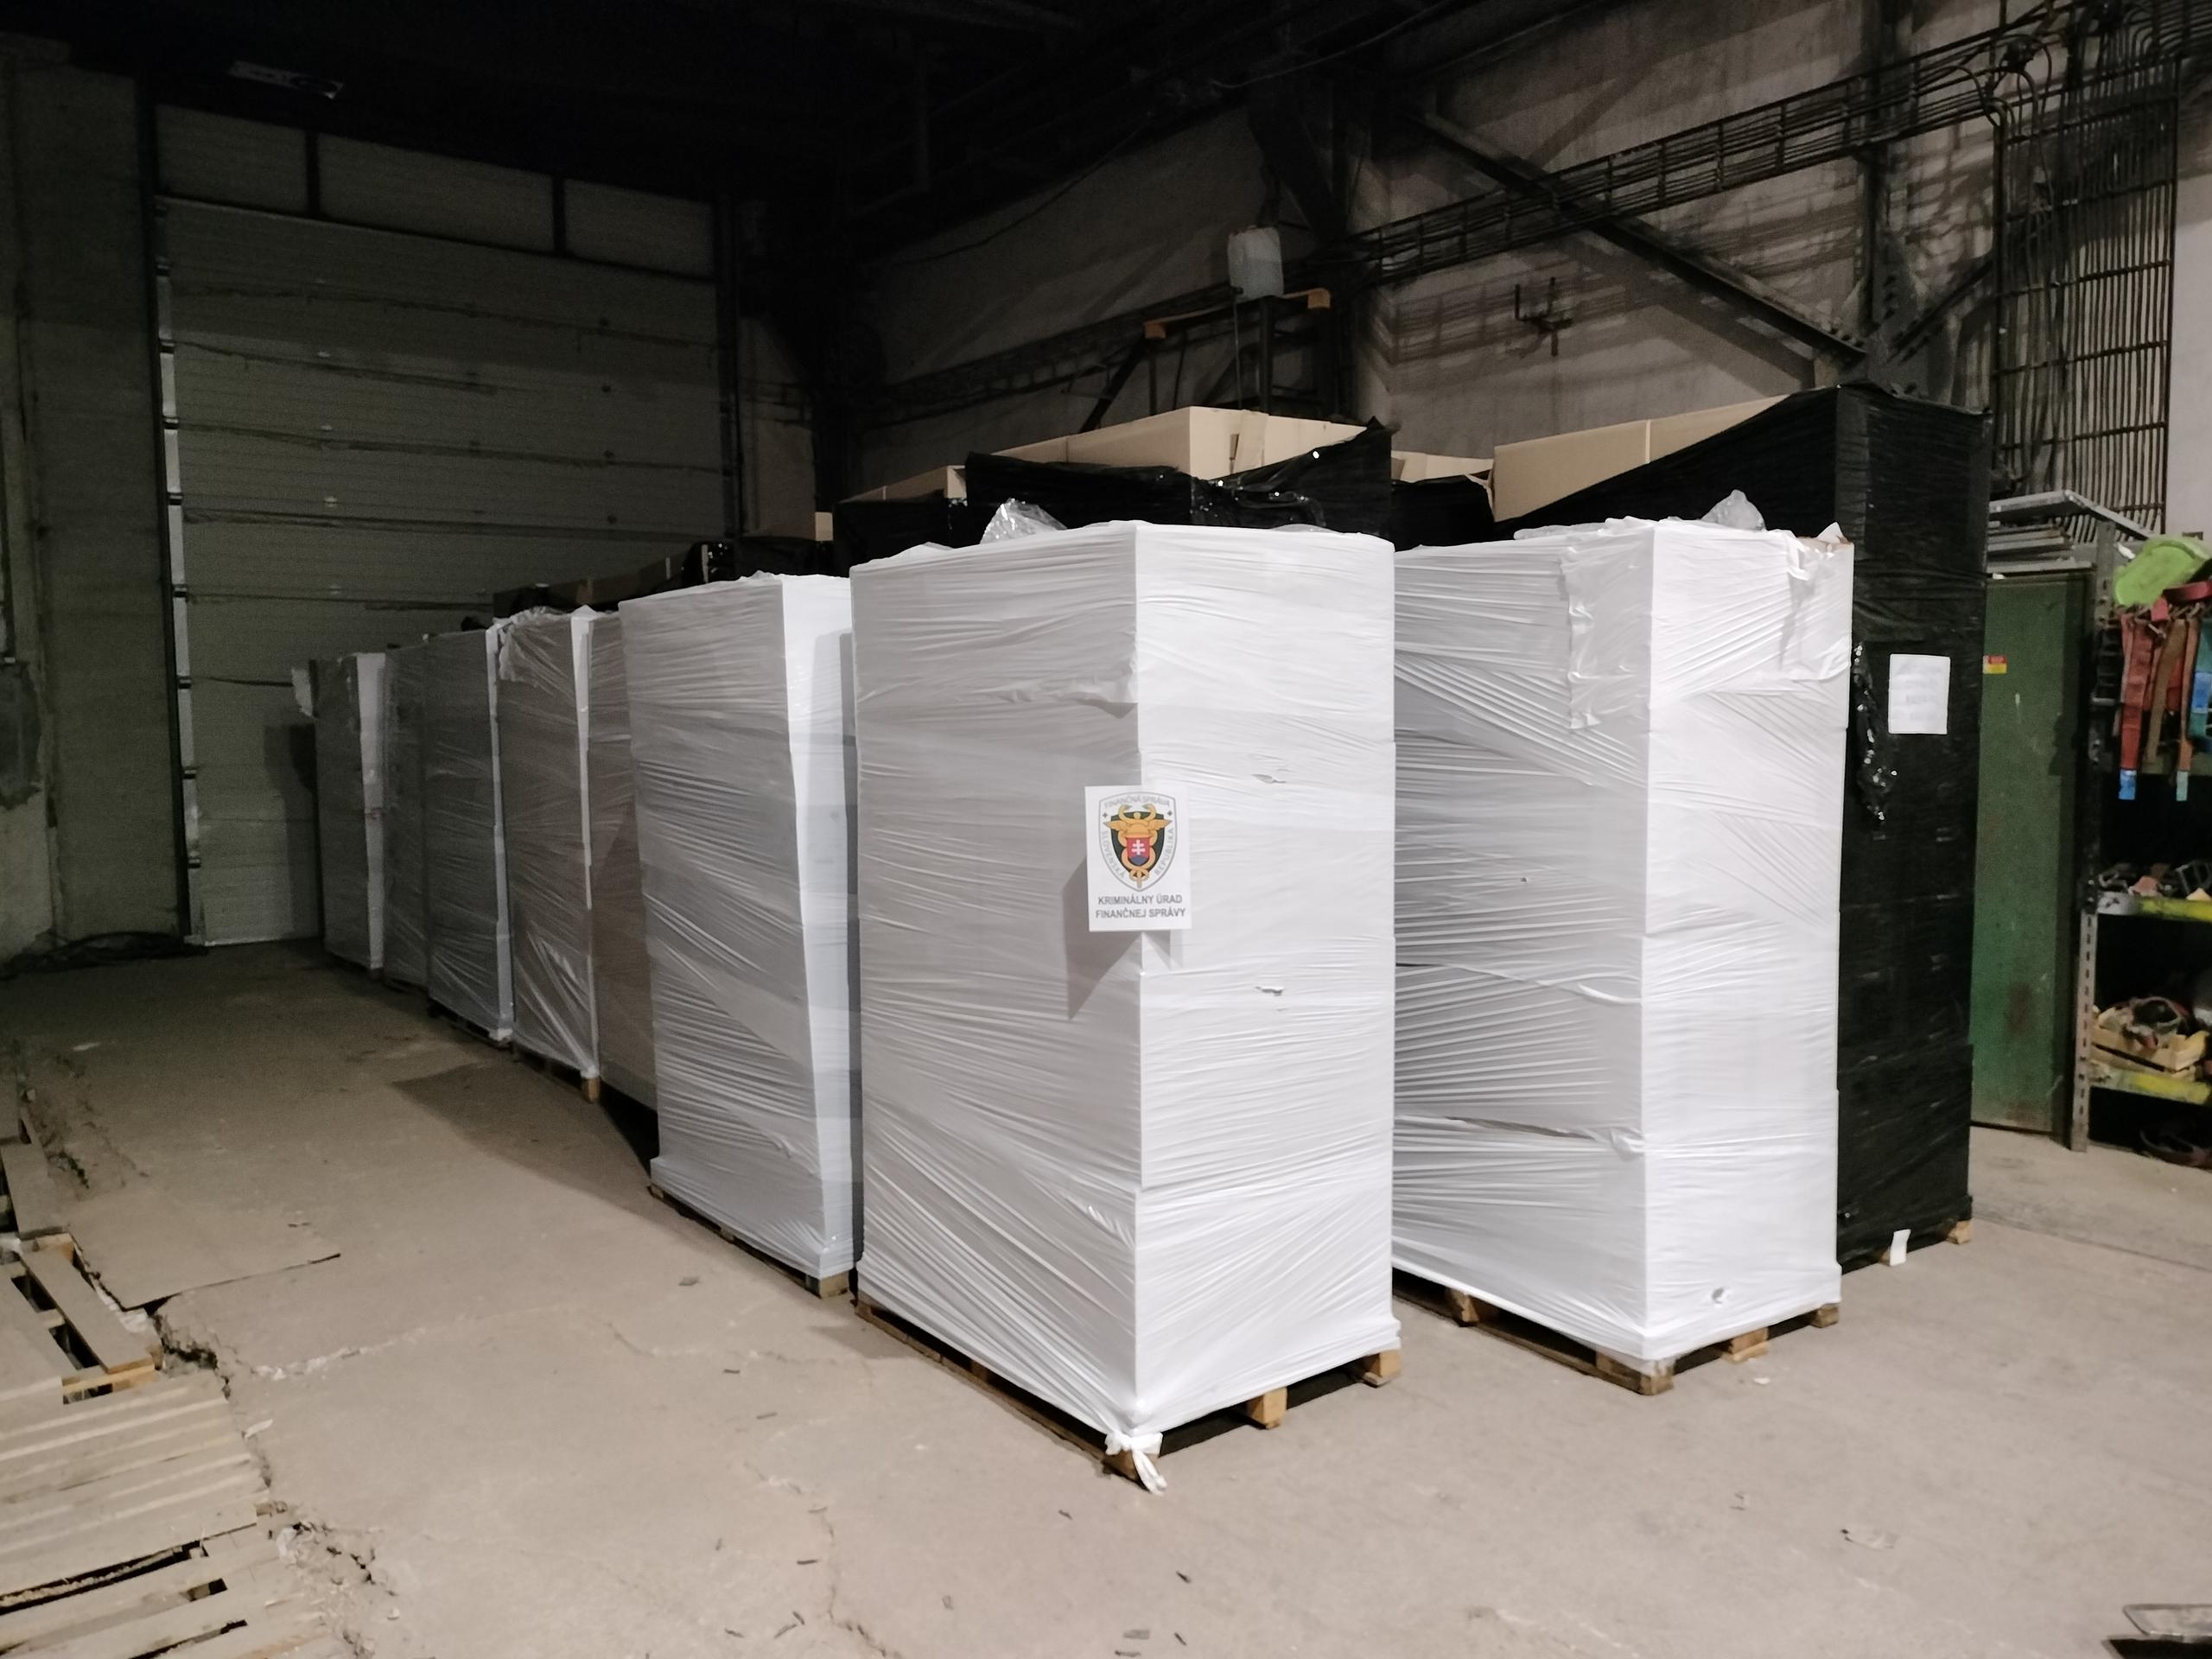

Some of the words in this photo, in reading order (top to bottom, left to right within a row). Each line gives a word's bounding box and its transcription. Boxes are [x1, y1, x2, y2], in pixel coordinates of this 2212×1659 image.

[1141, 795, 1170, 806] SPRÁVA
[1154, 828, 1174, 876] REPUBLIKA
[1098, 893, 1154, 905] KRIMINÁLNY
[1156, 893, 1182, 904] ÚRAD
[1096, 907, 1146, 918] FINANČNEJ
[1149, 906, 1185, 918] SPRÁVY
